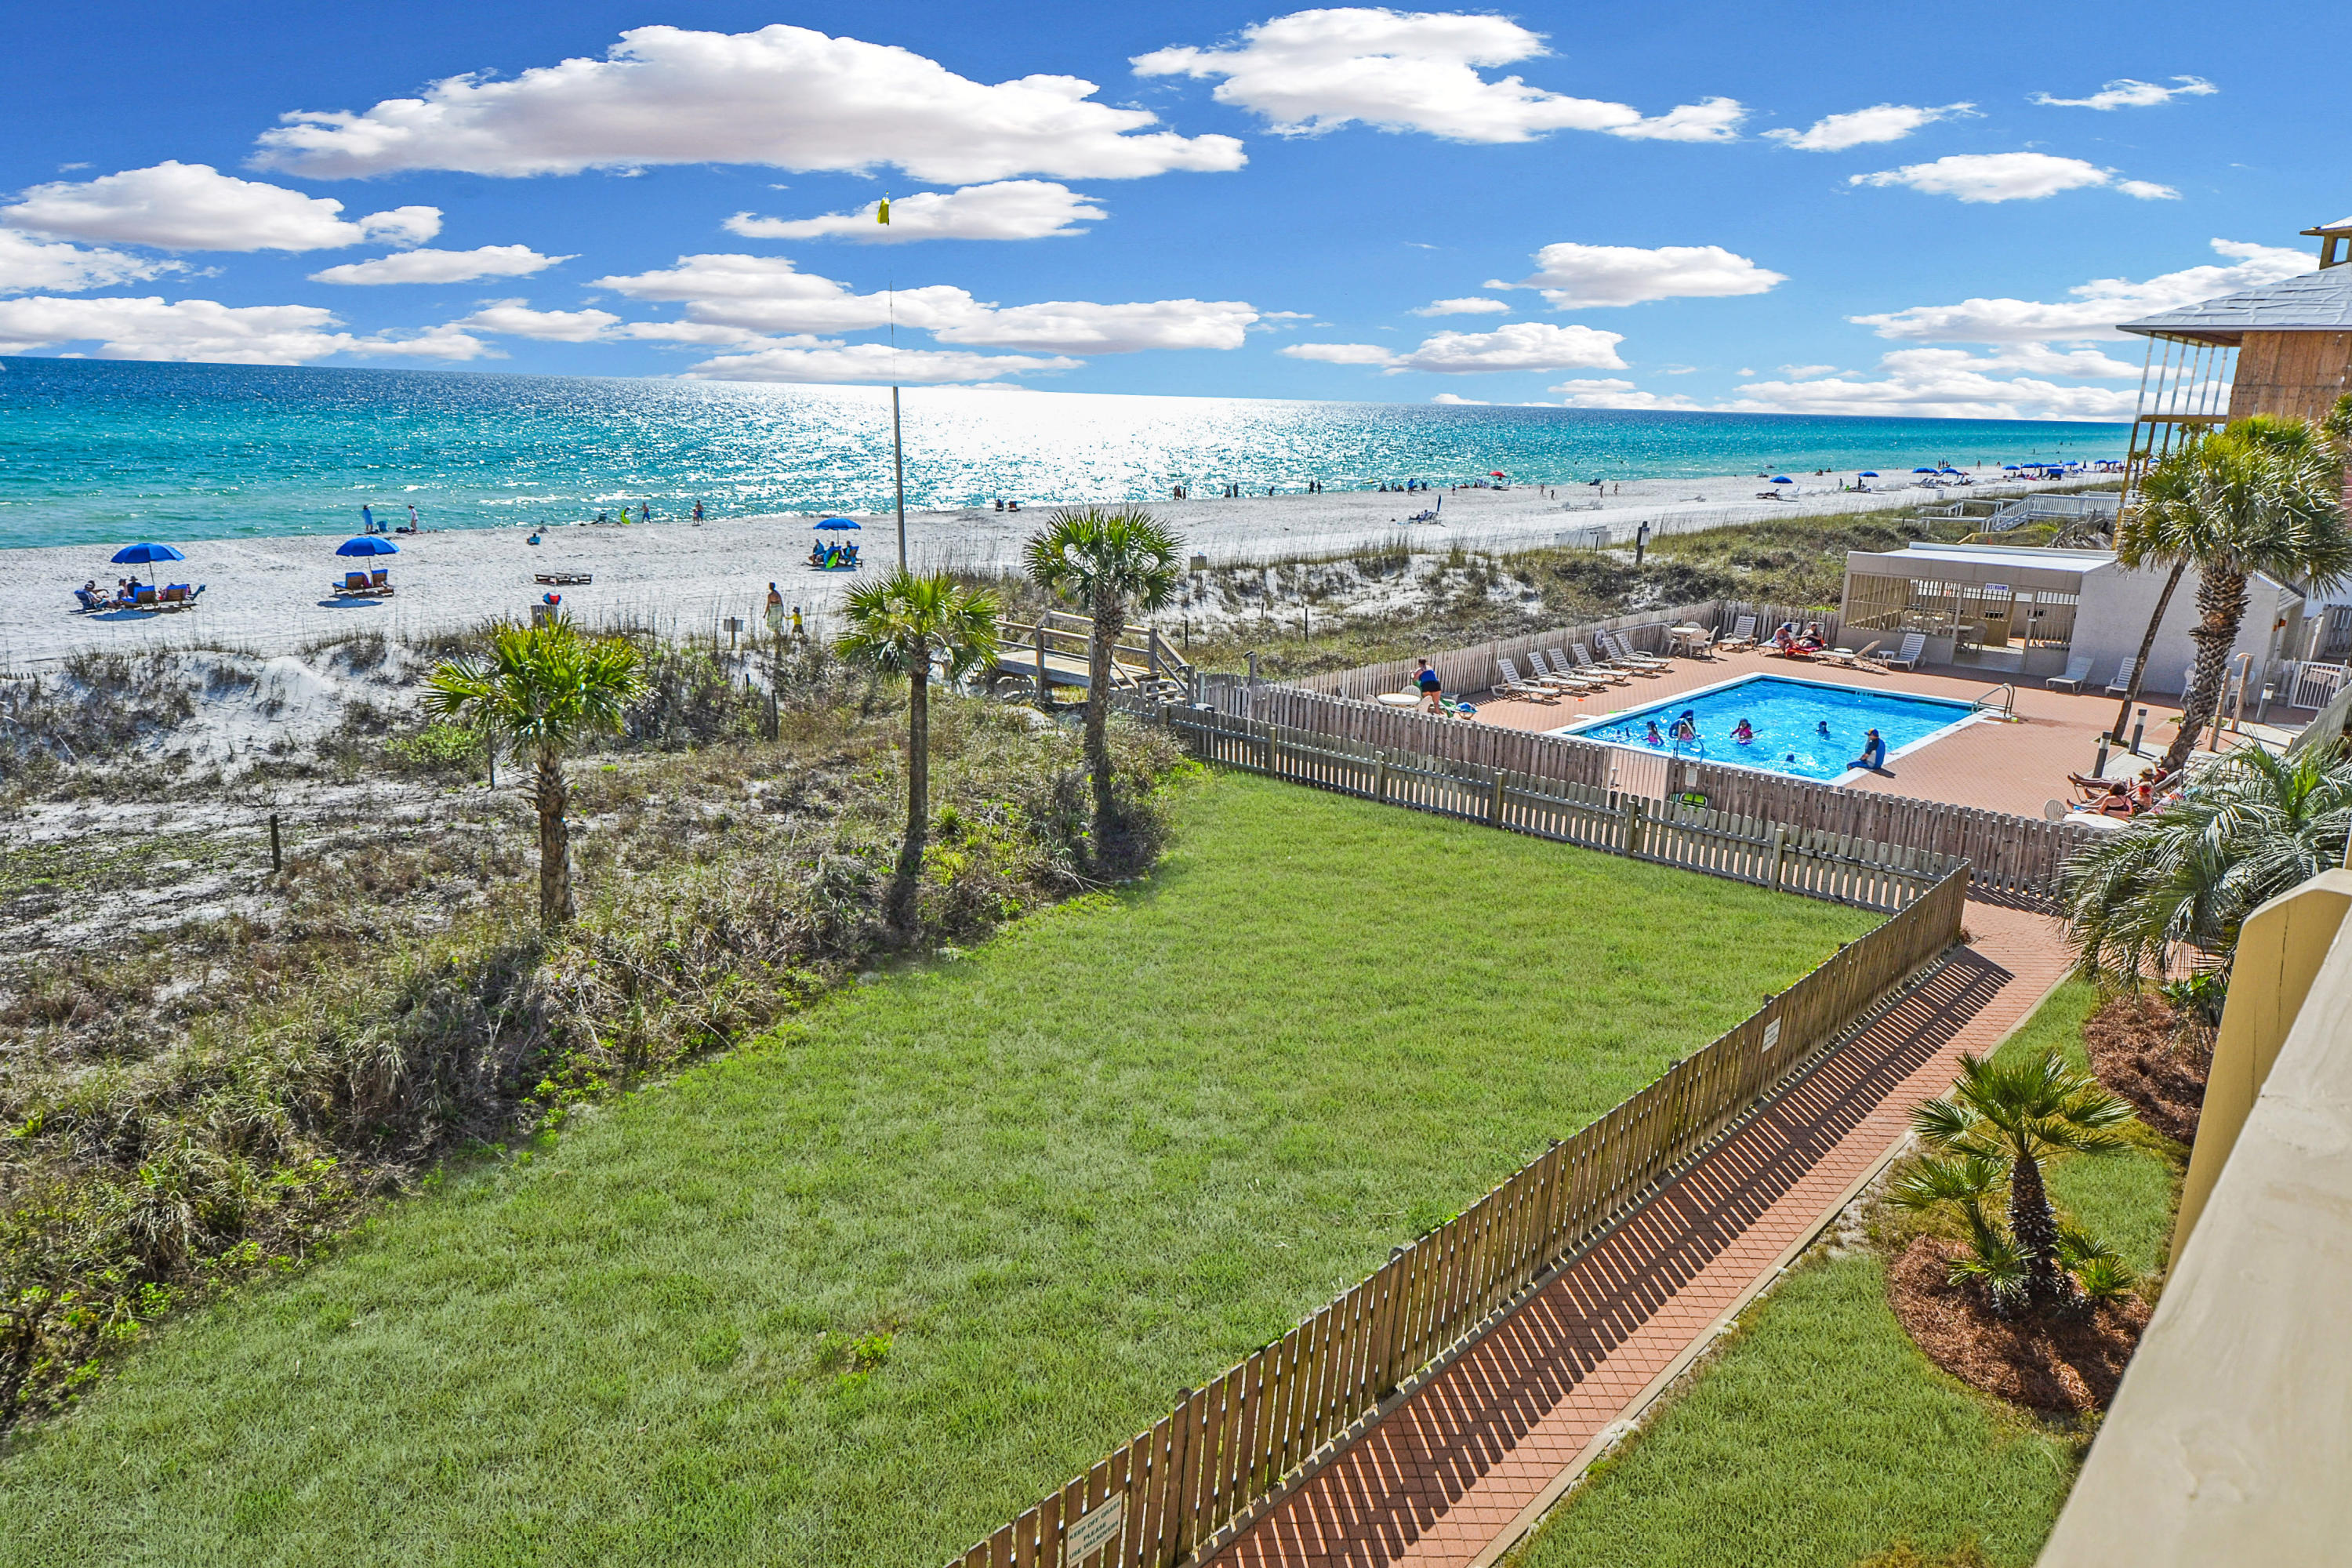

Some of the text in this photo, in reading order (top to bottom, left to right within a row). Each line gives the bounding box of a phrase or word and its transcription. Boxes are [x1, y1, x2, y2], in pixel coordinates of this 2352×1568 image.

[1069, 1501, 1120, 1541] KEEP OFF GRASS
[1069, 1519, 1119, 1559] USE WALKOVERS
[1083, 1522, 1106, 1541] PLEASE
